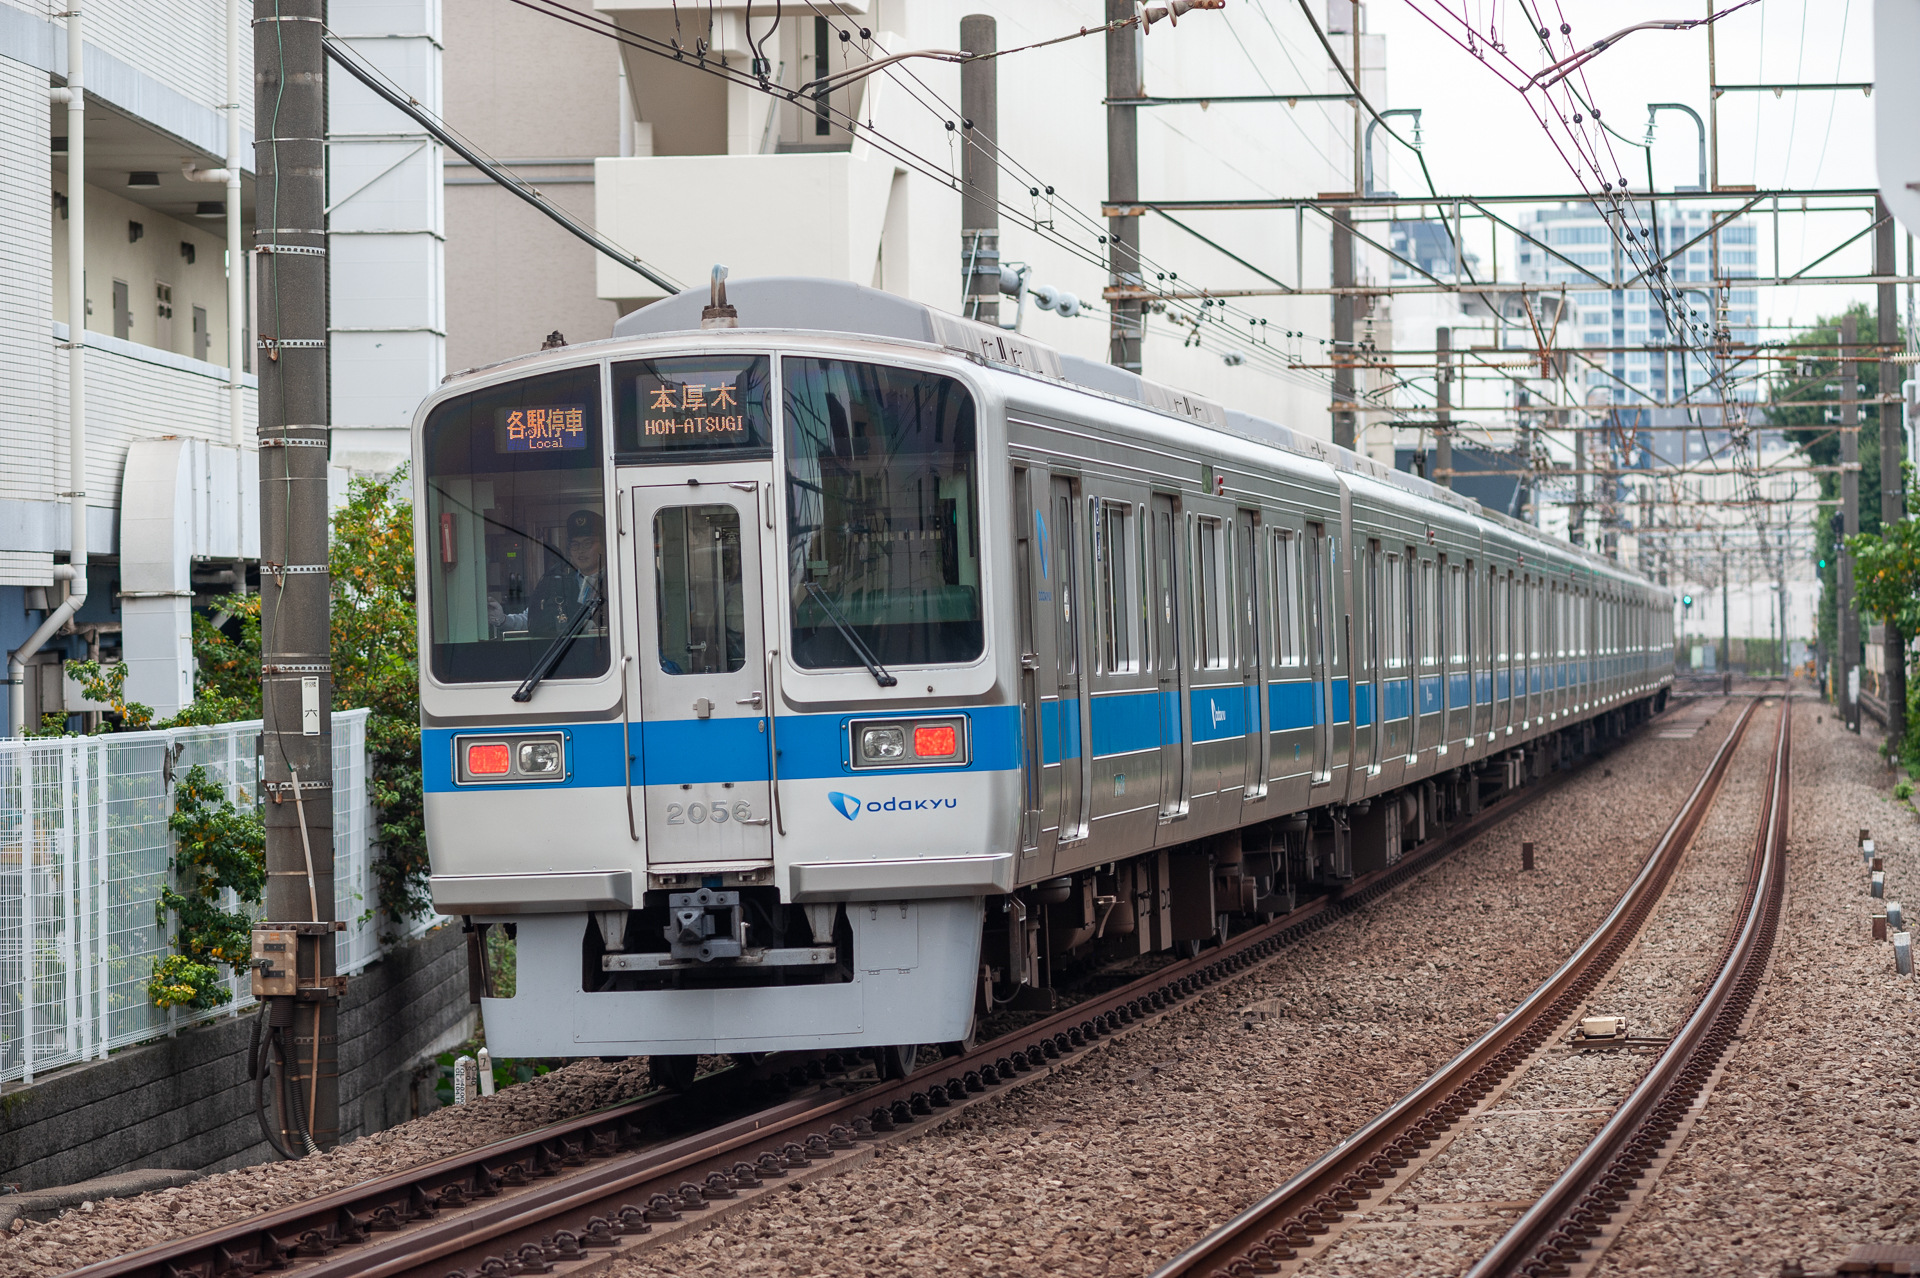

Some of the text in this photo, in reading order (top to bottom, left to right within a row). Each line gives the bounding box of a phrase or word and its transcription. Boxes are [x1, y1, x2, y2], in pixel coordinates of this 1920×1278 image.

[650, 382, 737, 412] 本厚木
[507, 408, 583, 439] 各駅停車
[645, 416, 743, 435] HON-ATSUGI
[529, 438, 563, 449] Local
[667, 800, 752, 824] 2056
[867, 797, 957, 812] odakyu
[481, 1058, 486, 1067] 7
